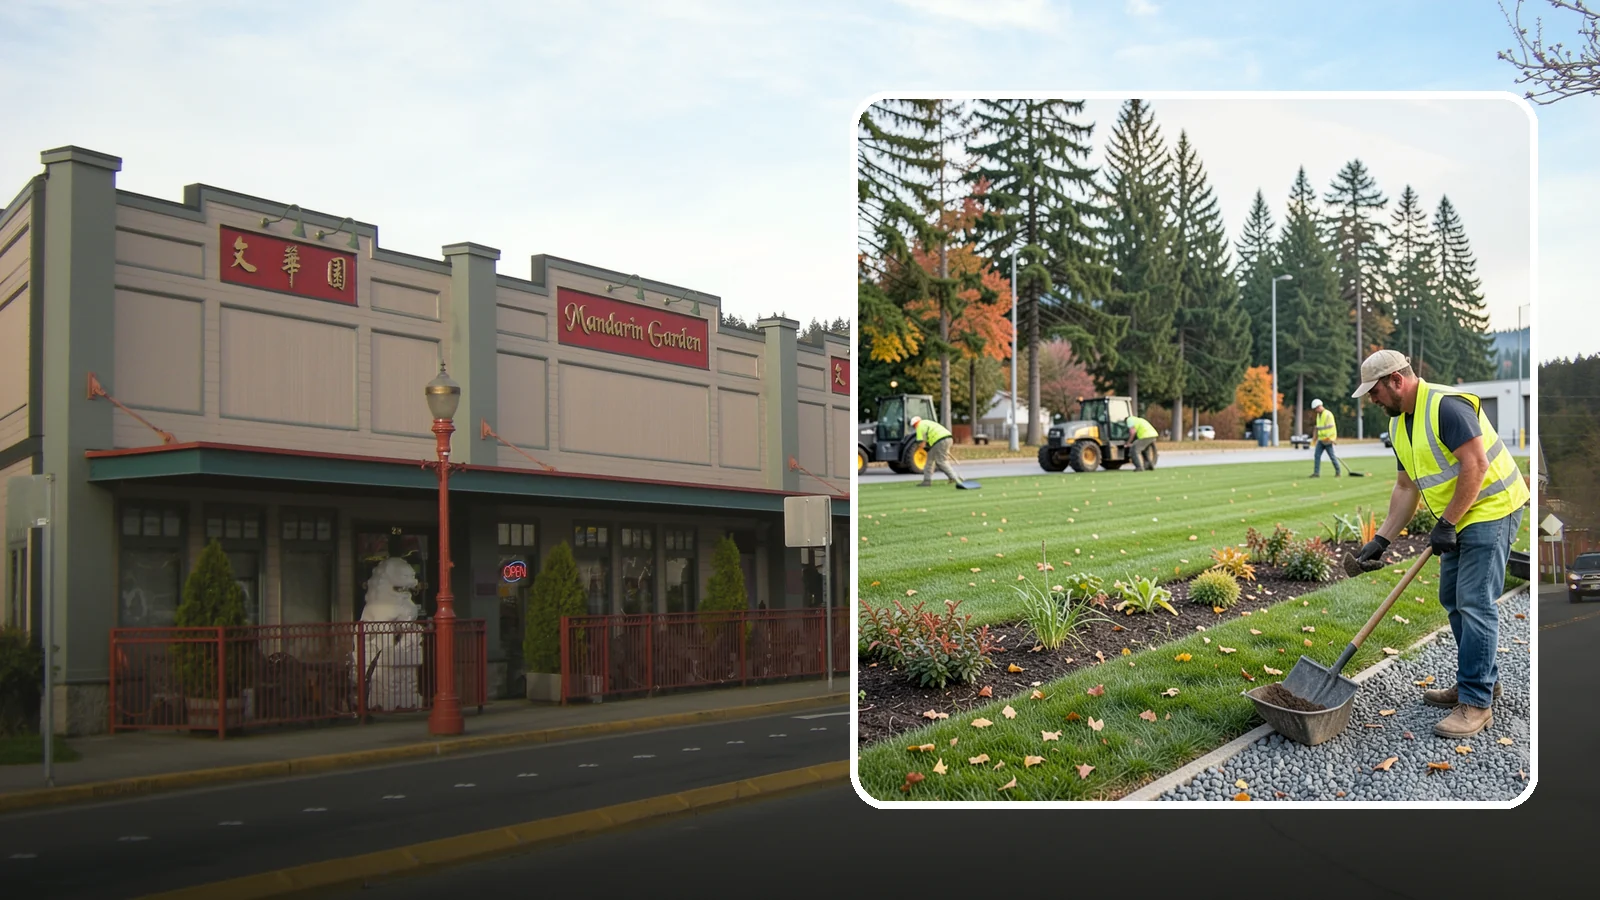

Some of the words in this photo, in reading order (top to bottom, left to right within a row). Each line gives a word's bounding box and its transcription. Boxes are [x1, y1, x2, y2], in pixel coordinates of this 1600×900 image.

[231, 236, 346, 290] 文華園
[565, 302, 643, 341] Mandarin
[648, 320, 701, 352] Garden
[503, 565, 527, 578] OPEN
